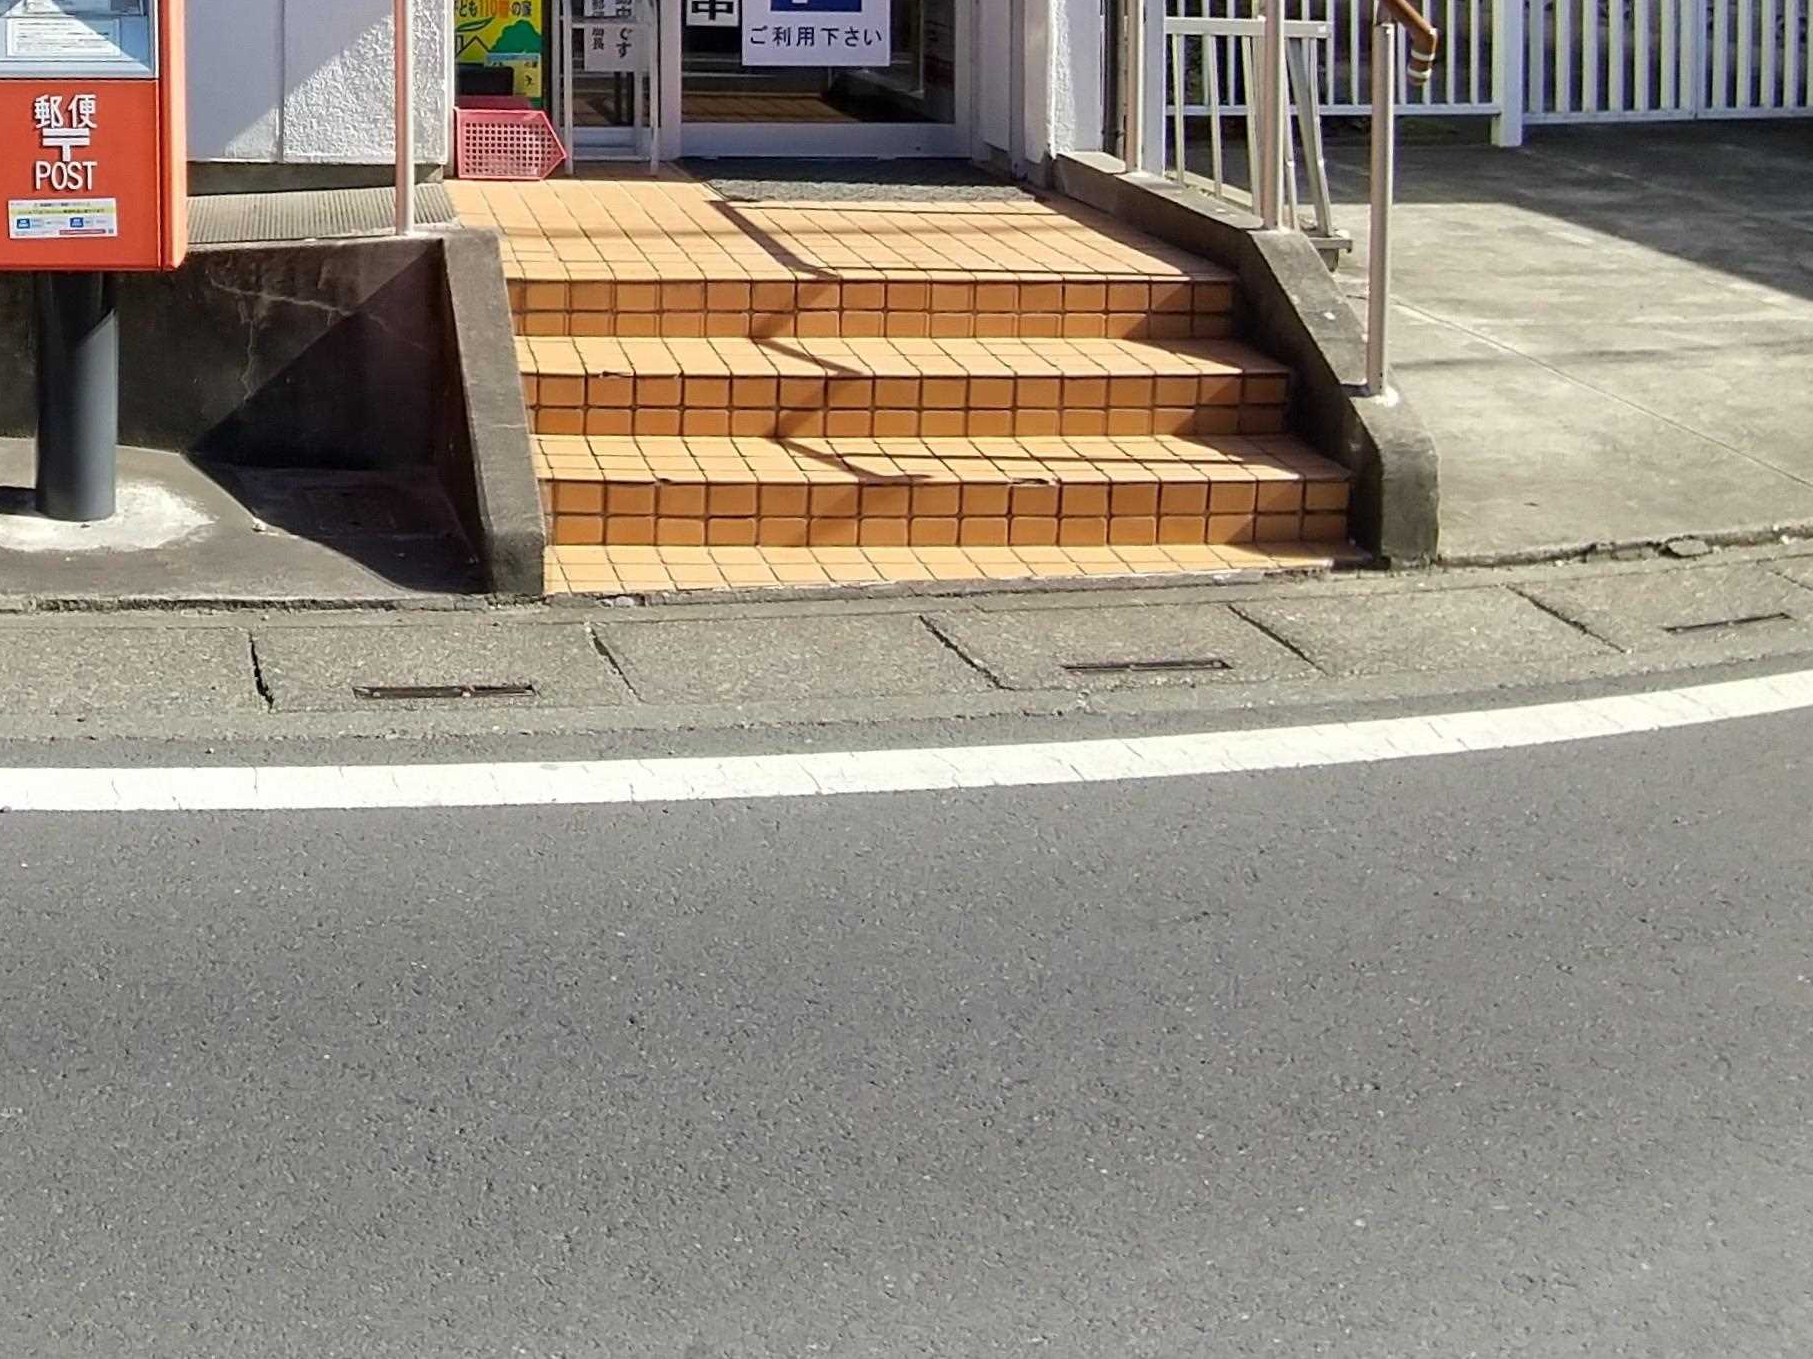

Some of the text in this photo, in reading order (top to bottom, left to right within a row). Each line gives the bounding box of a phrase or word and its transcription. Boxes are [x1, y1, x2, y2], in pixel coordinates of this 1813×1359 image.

[750, 25, 882, 47] ご利用下さい
[34, 94, 98, 129] 郵便
[35, 161, 98, 190] POST
